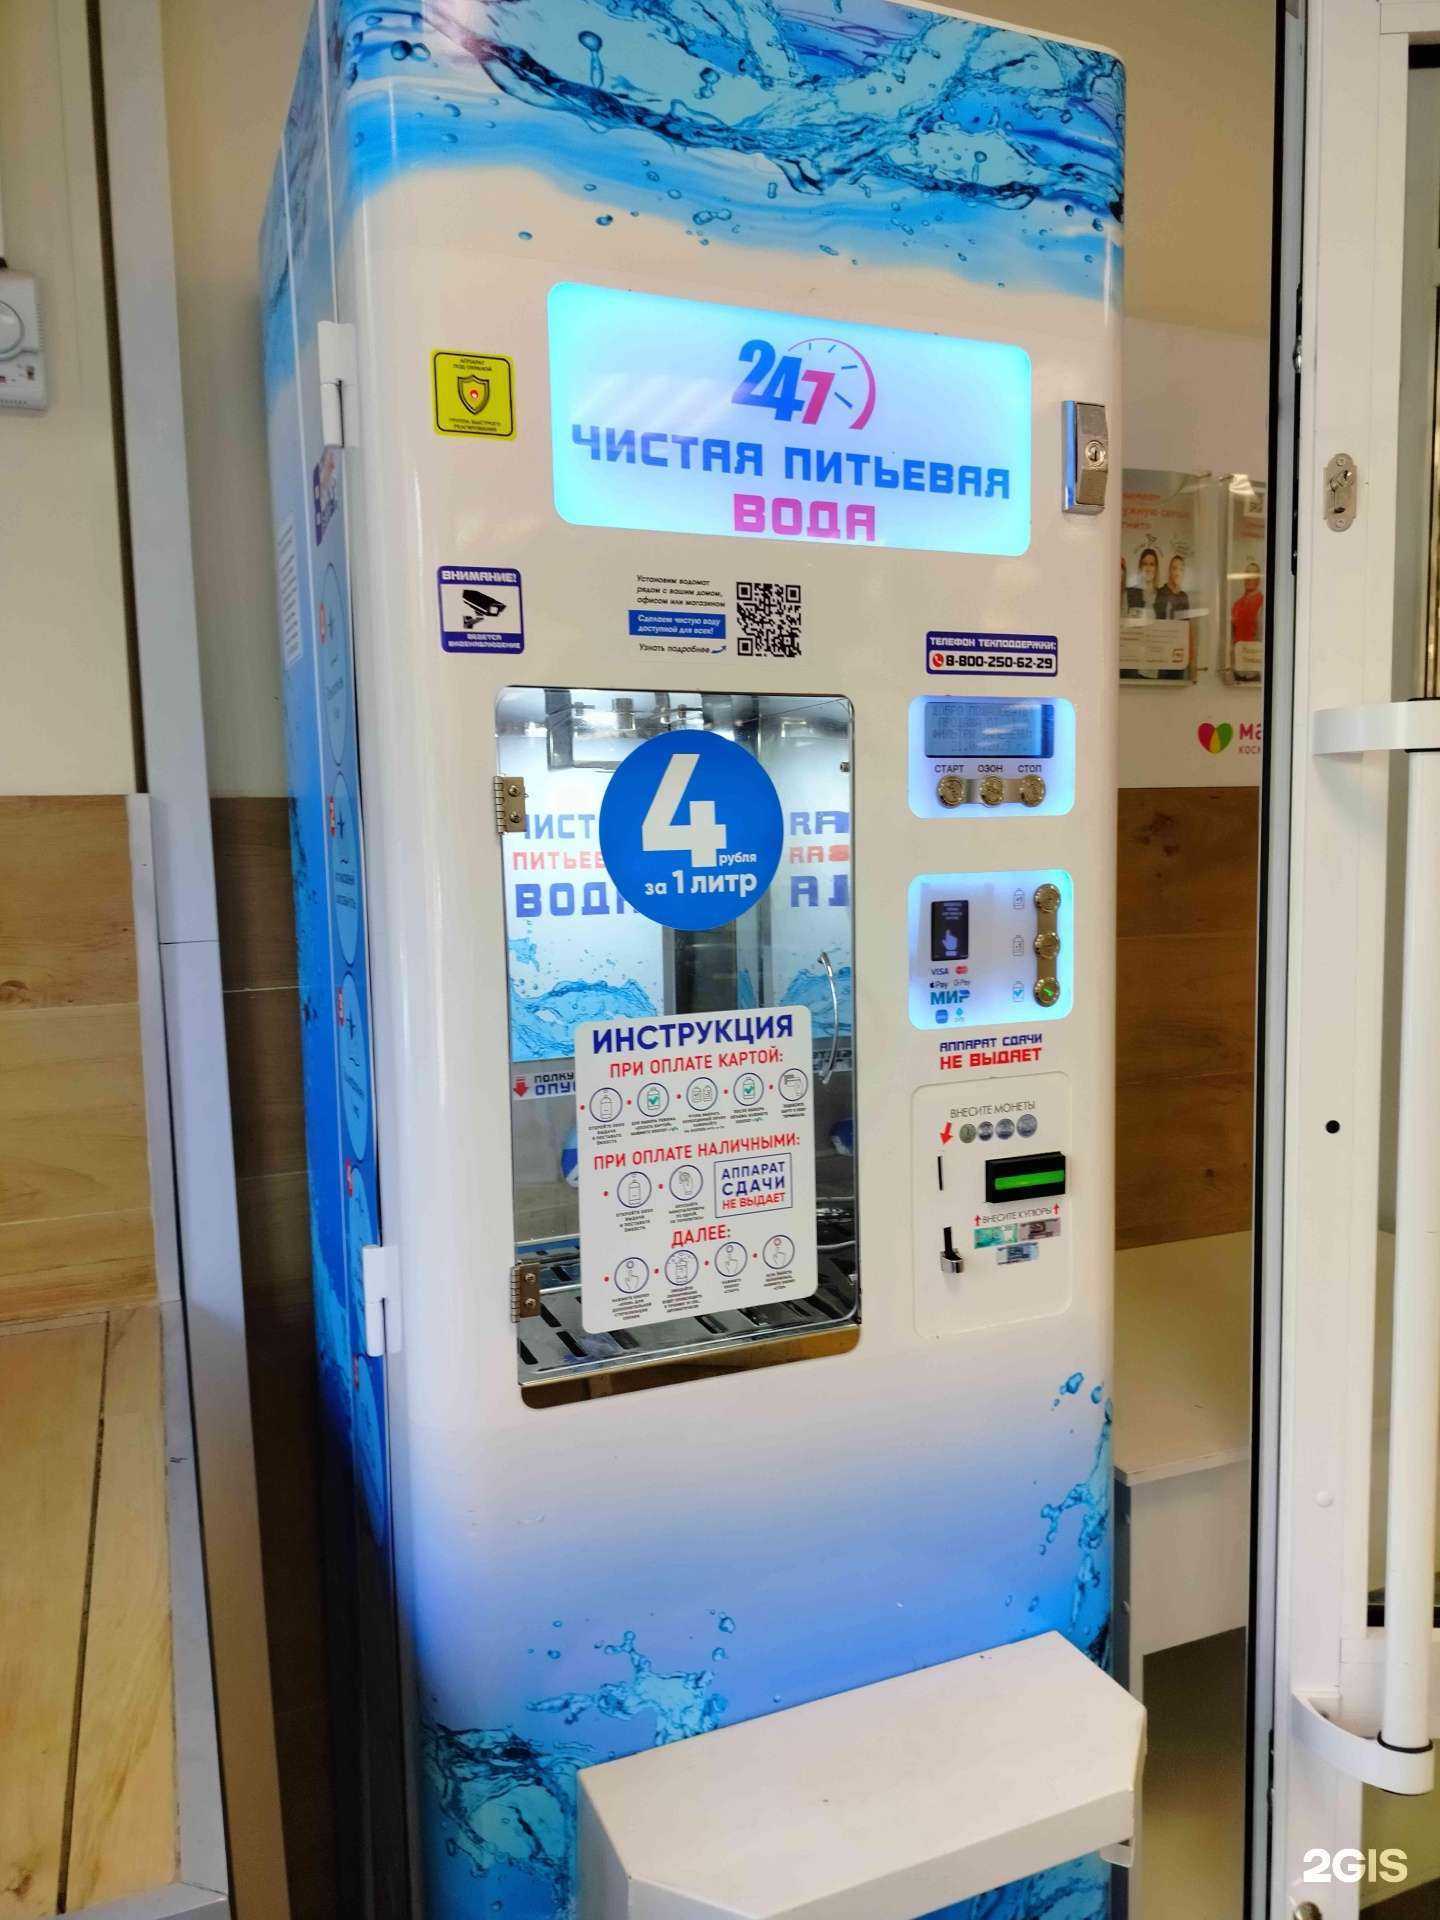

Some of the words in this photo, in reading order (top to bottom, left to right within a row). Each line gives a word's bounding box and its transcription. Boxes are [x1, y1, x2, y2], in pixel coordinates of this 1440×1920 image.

[572, 423, 763, 476] ЧИСТАЯ
[784, 446, 1009, 499] ПИТЬЕВАЯ
[734, 493, 876, 542] ВОДА
[441, 571, 517, 582] ВНИМАНИЕ!
[930, 637, 975, 647] ТЕЛЕФОН
[946, 655, 1053, 669] 8-800-250-62-29
[934, 764, 964, 773] СТАРТ
[977, 764, 1003, 773] ОЗОН
[1017, 764, 1042, 773] СТОП
[642, 753, 727, 868] 4
[525, 814, 596, 839] ИСТ
[719, 851, 757, 866] рубля
[644, 881, 667, 896] за
[672, 870, 684, 894] 1
[691, 871, 758, 897] литр
[930, 989, 970, 1005] МИР
[593, 1014, 793, 1054] ИНСТРУКЦИЯ
[940, 1038, 997, 1052] АППАРАТ
[1002, 1033, 1043, 1047] СДАЧИ
[610, 1061, 644, 1078] ПРИ
[650, 1054, 712, 1075] ОПЛАТЕ
[718, 1046, 784, 1067] КАРТОЙ:
[940, 1055, 962, 1070] НЕ
[970, 1047, 1042, 1068] ВЫДАЕТ
[950, 1104, 993, 1118] ВНЕСИТЕ
[994, 1100, 1036, 1113] МОНЕТЫ
[594, 1154, 626, 1170] ПРИ
[632, 1144, 692, 1165] ОПЛАТЕ
[698, 1132, 800, 1157] НАЛИЧНЫМИ:
[721, 1161, 785, 1180] АППАРАТ
[722, 1175, 785, 1197] СДАЧИ
[722, 1197, 737, 1211] НЕ
[739, 1192, 785, 1209] ВЫДАЕТ
[671, 1224, 731, 1248] ДАЛЕЕ:
